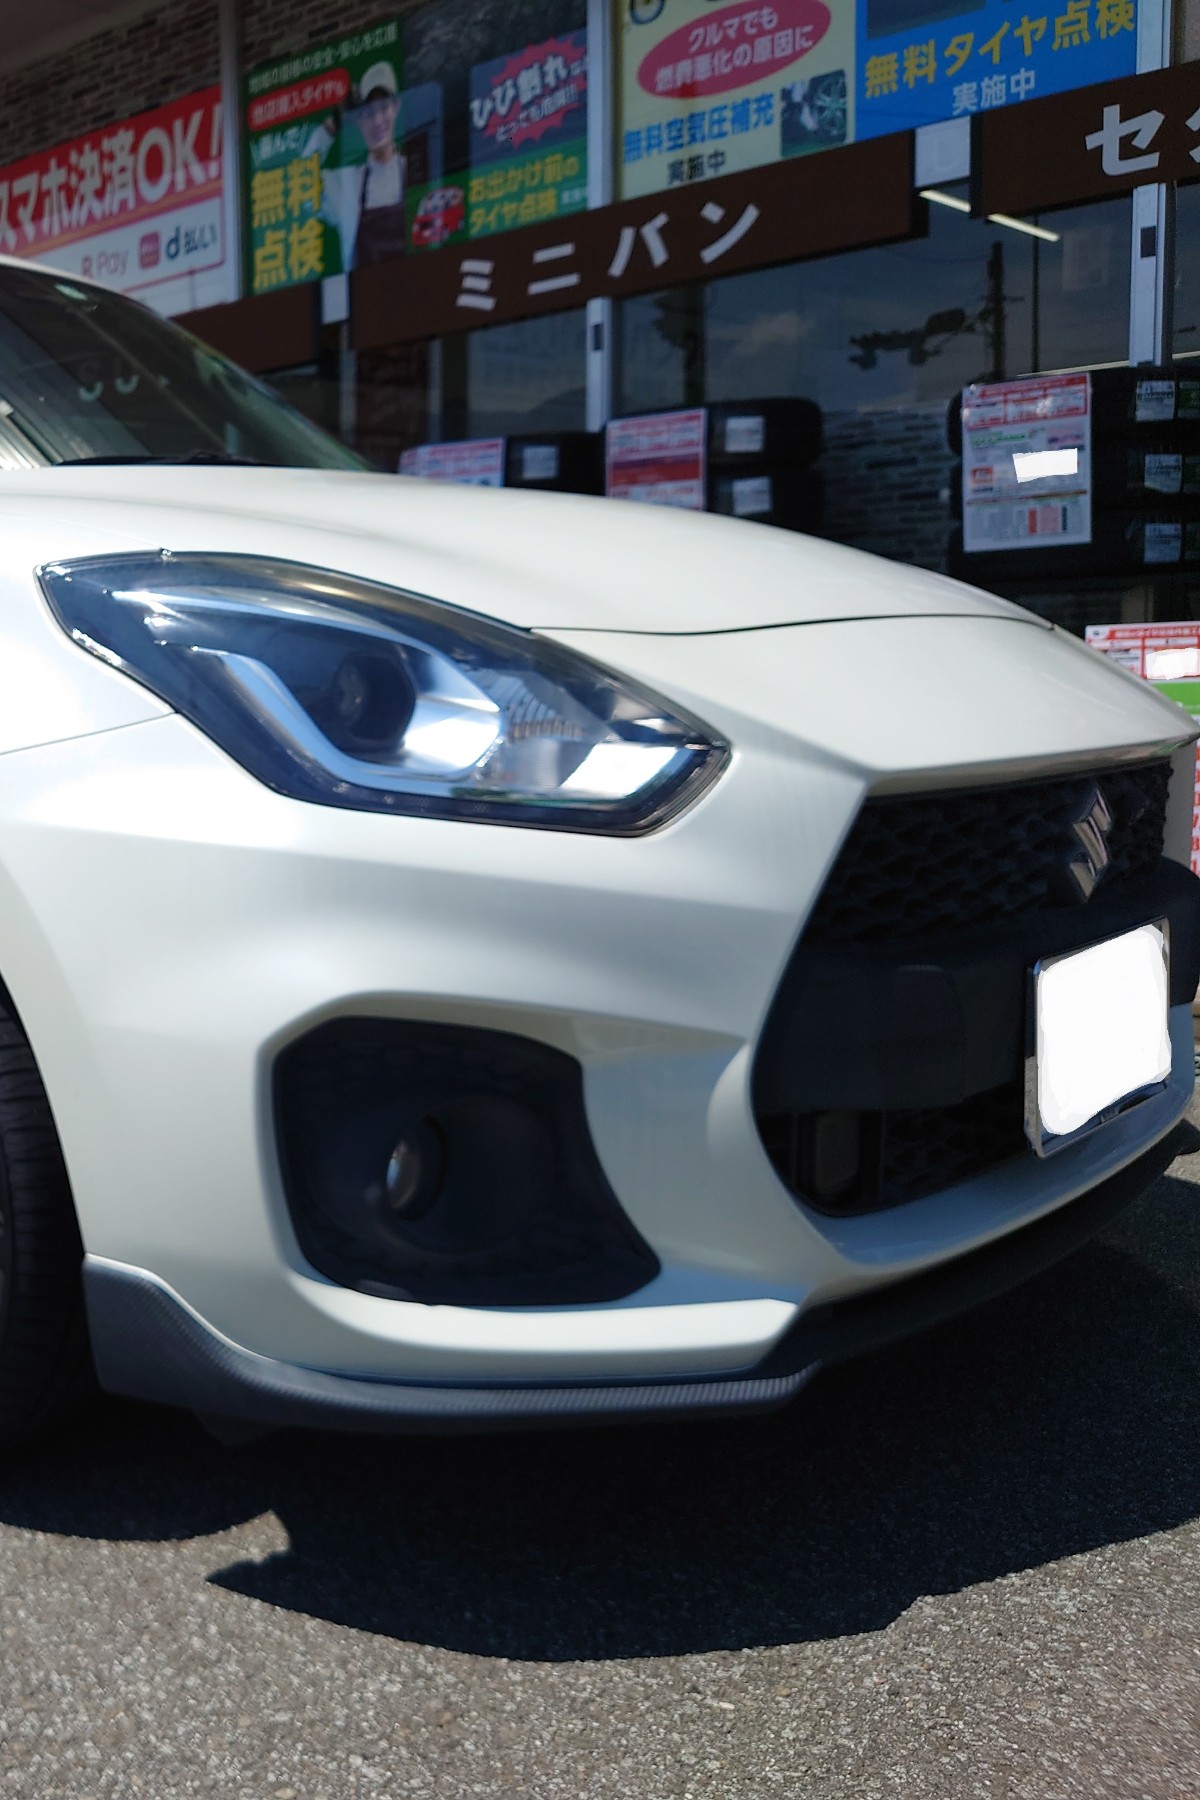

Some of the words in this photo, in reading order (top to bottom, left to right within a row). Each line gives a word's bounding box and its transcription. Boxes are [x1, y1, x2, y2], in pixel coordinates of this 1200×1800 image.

[655, 25, 814, 92] 燃費悪化の原因に
[688, 7, 778, 53] クルマでも
[864, 0, 1136, 99] 無料タイヤ点検
[952, 67, 1036, 117] 実施中
[624, 92, 774, 164] 無料空気圧補充
[252, 152, 323, 228] 無料
[667, 150, 726, 185] 実施中
[469, 188, 557, 237] タイヤ点検
[254, 217, 325, 289] 点検
[456, 202, 761, 311] ミニバン
